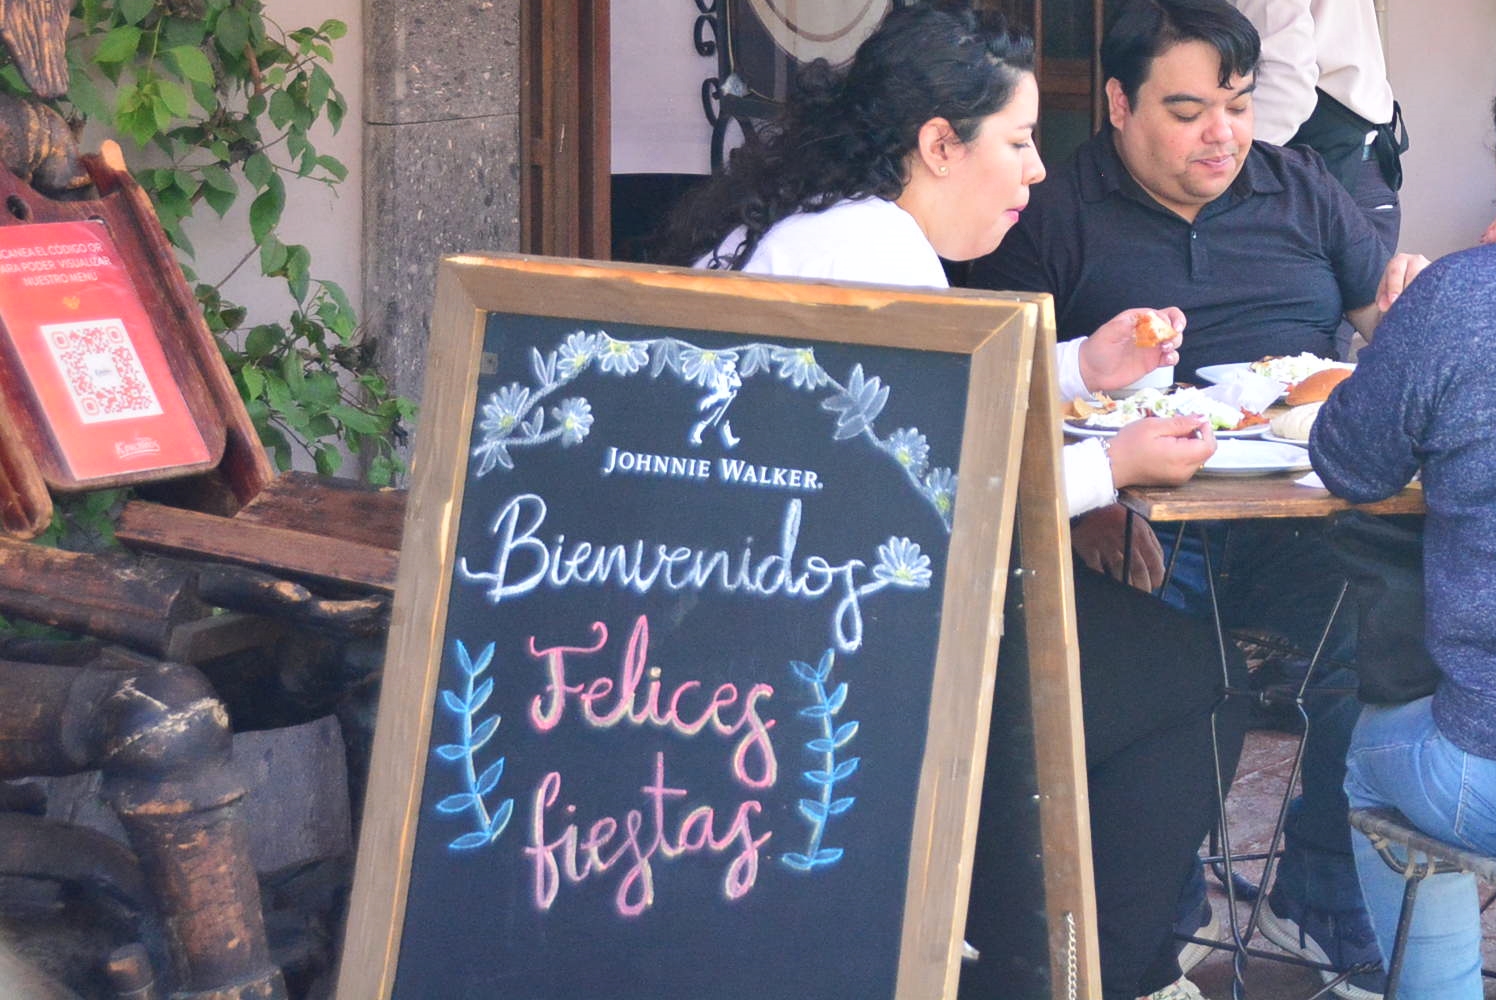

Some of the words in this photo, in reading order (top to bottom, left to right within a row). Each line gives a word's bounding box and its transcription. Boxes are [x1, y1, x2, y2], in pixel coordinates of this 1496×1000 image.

[604, 447, 712, 479] JOHNNIE
[460, 494, 868, 653] Bienvenidos
[529, 615, 778, 788] Felices
[525, 751, 772, 915] fiestas
